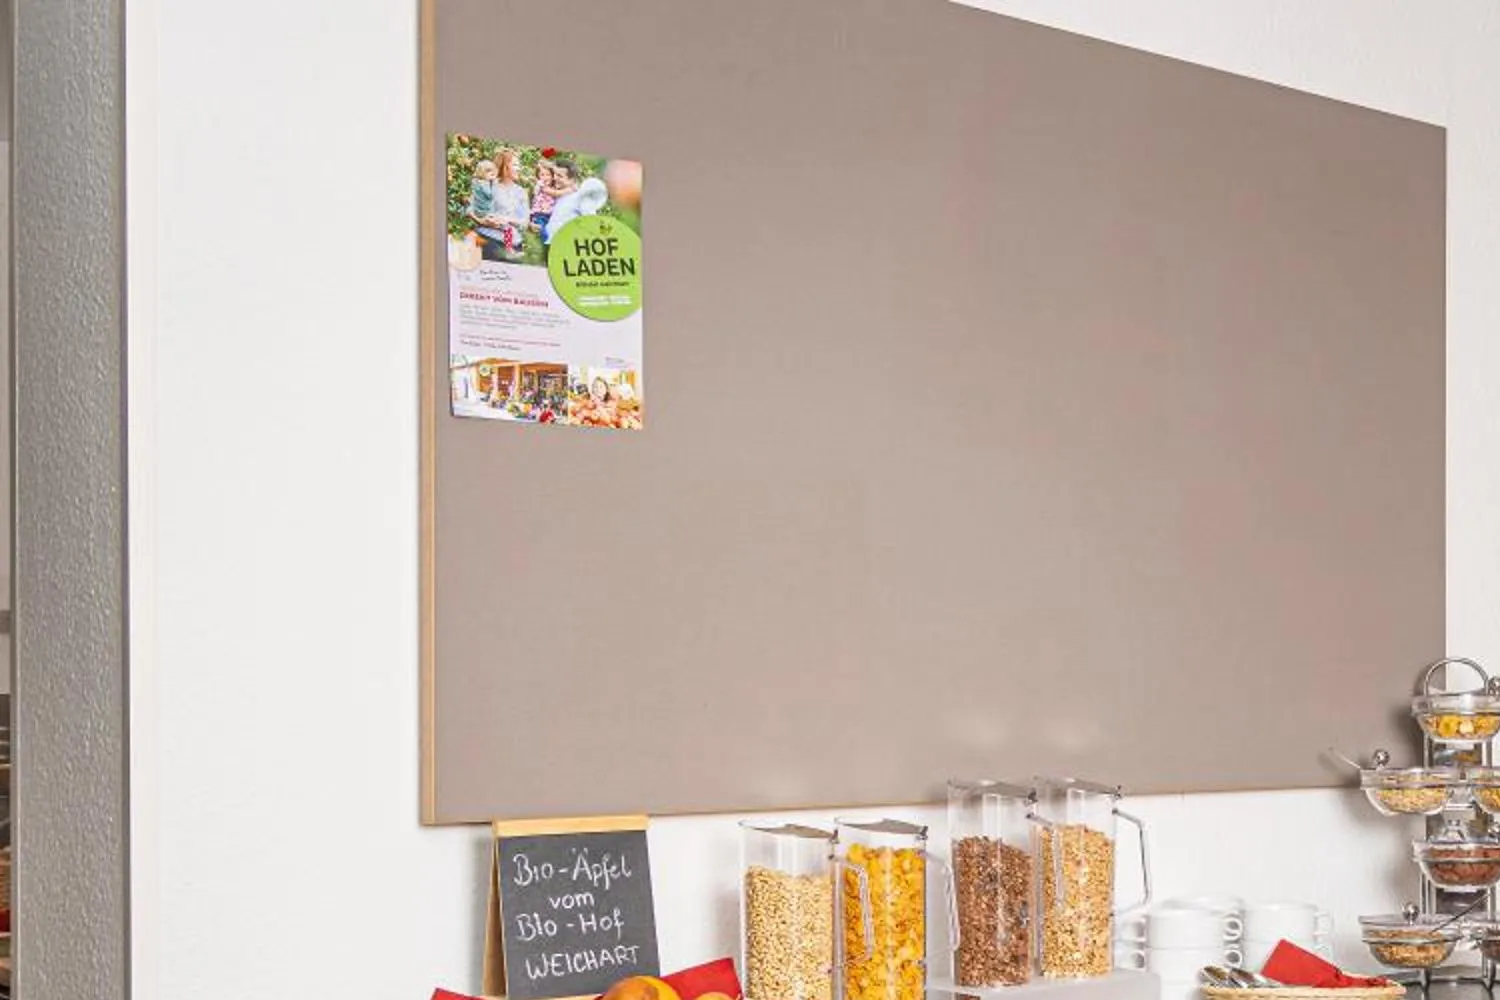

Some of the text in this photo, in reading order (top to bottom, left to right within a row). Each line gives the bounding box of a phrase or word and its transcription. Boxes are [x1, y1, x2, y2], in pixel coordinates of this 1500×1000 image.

[574, 238, 618, 256] HOF
[563, 258, 635, 277] LADEN
[549, 892, 595, 910] vom
[525, 945, 640, 980] WEICHART
